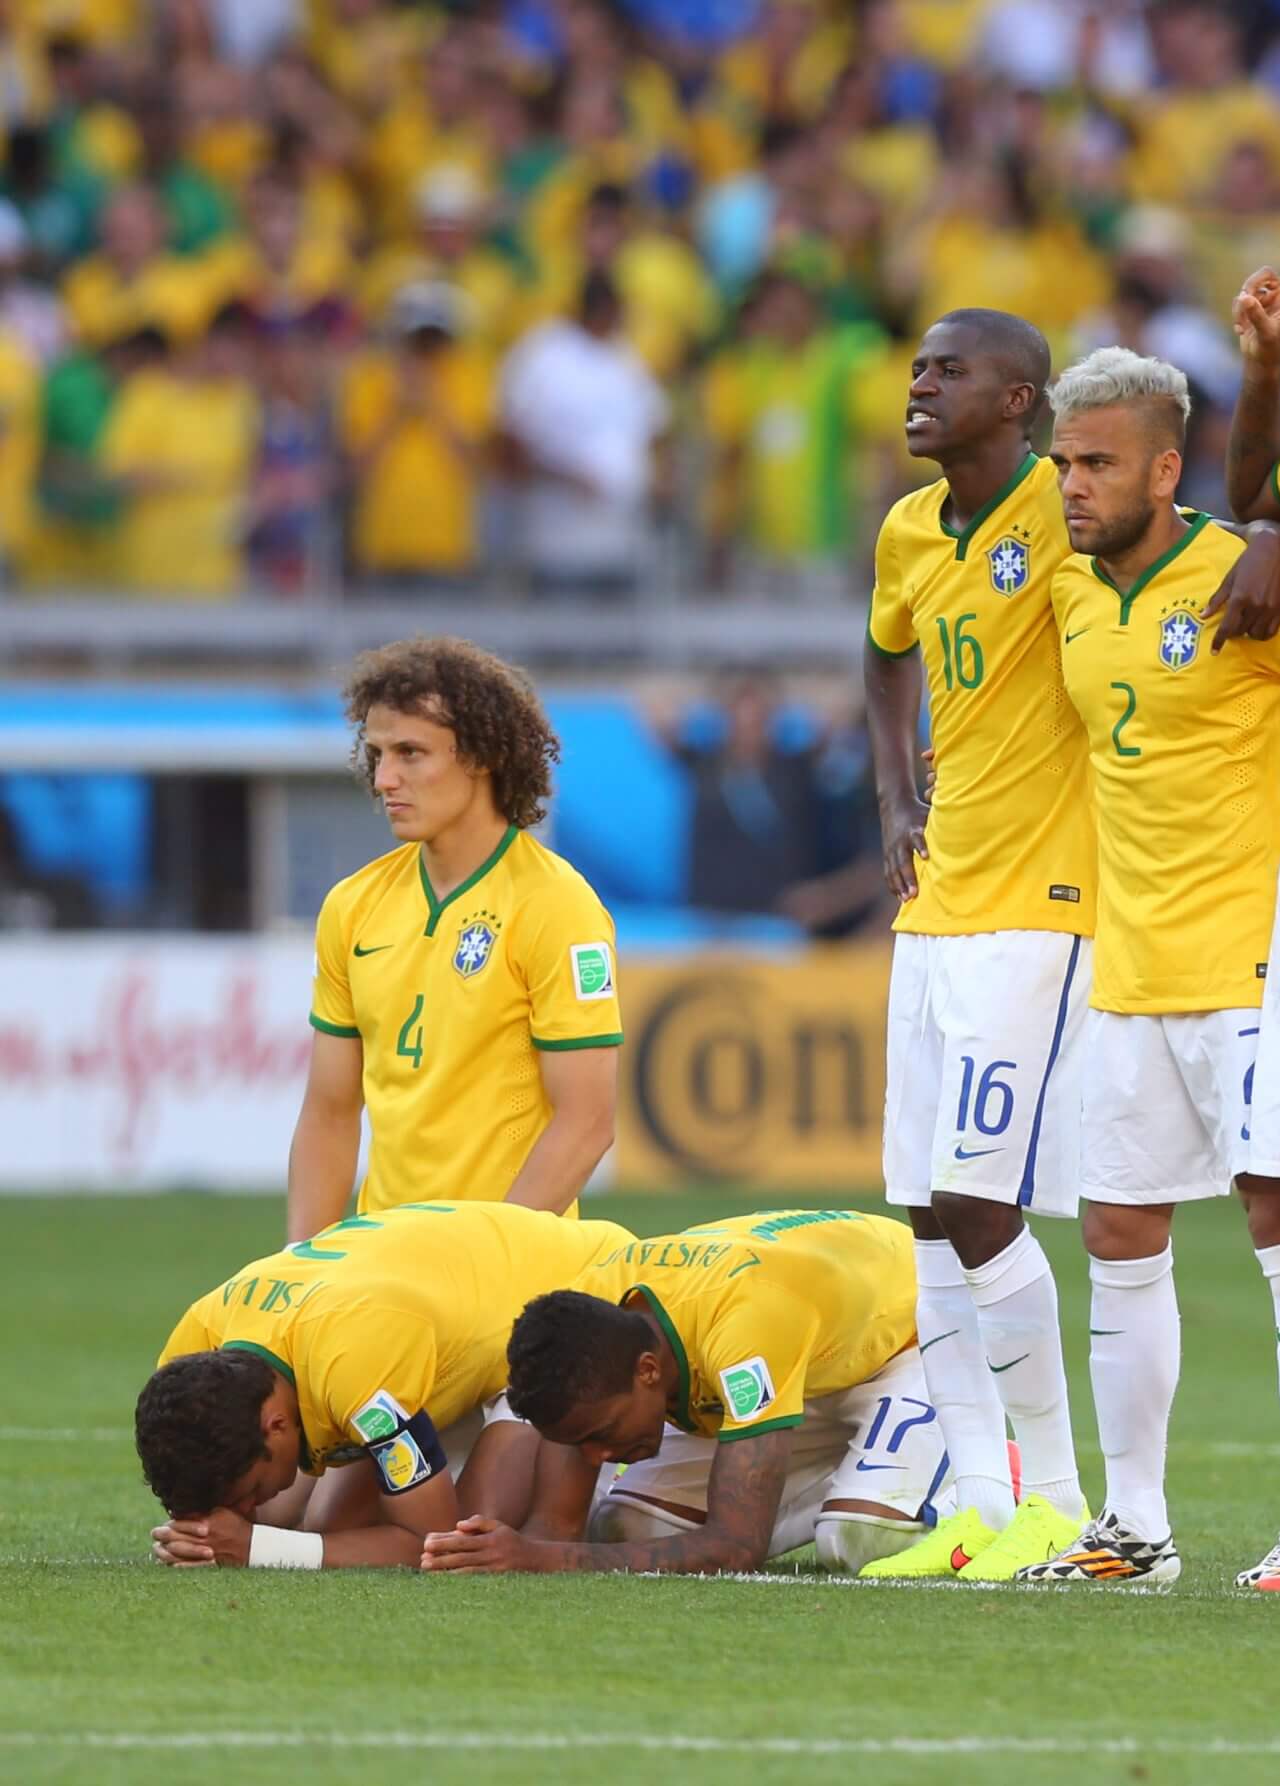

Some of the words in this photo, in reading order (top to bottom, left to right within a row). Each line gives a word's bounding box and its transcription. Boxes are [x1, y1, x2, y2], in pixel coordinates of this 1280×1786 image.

[936, 613, 984, 690] 16
[1111, 682, 1141, 756] 2
[397, 994, 424, 1069] 4
[956, 1055, 1017, 1136] 16
[863, 1396, 936, 1453] 17
